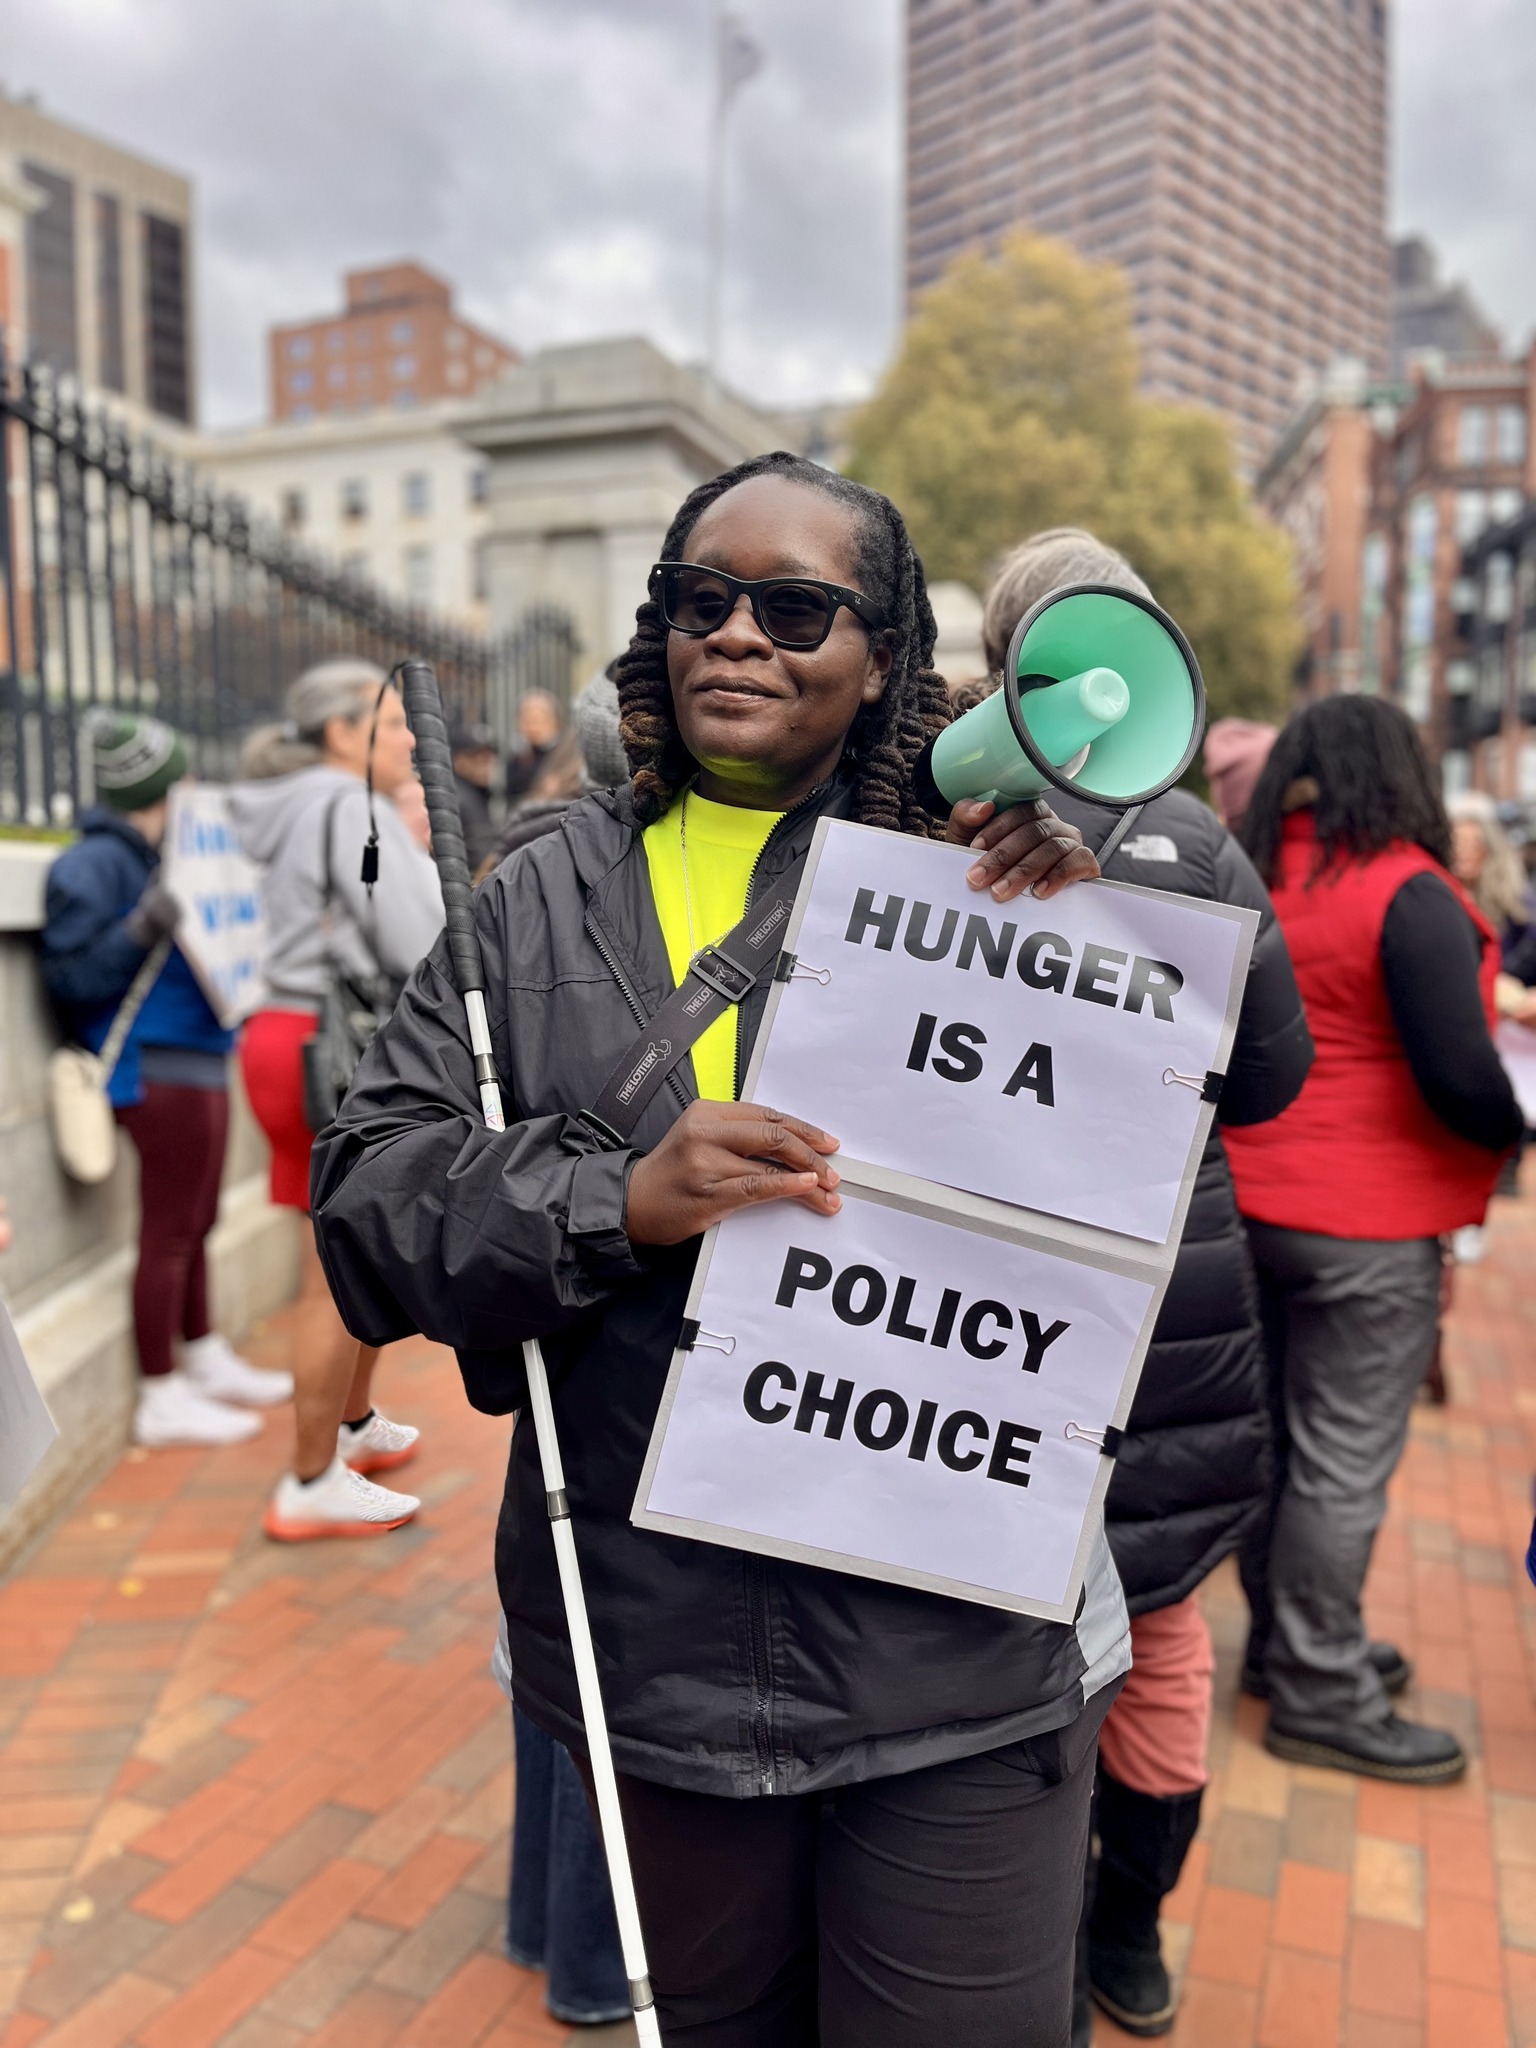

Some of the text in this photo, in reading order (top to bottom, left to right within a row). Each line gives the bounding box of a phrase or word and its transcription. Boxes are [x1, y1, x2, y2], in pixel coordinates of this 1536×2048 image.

[844, 887, 1184, 1023] HUNGER
[906, 1012, 1055, 1108] IS A
[775, 1246, 1072, 1375] POLICY
[743, 1361, 1043, 1488] CHOICE
